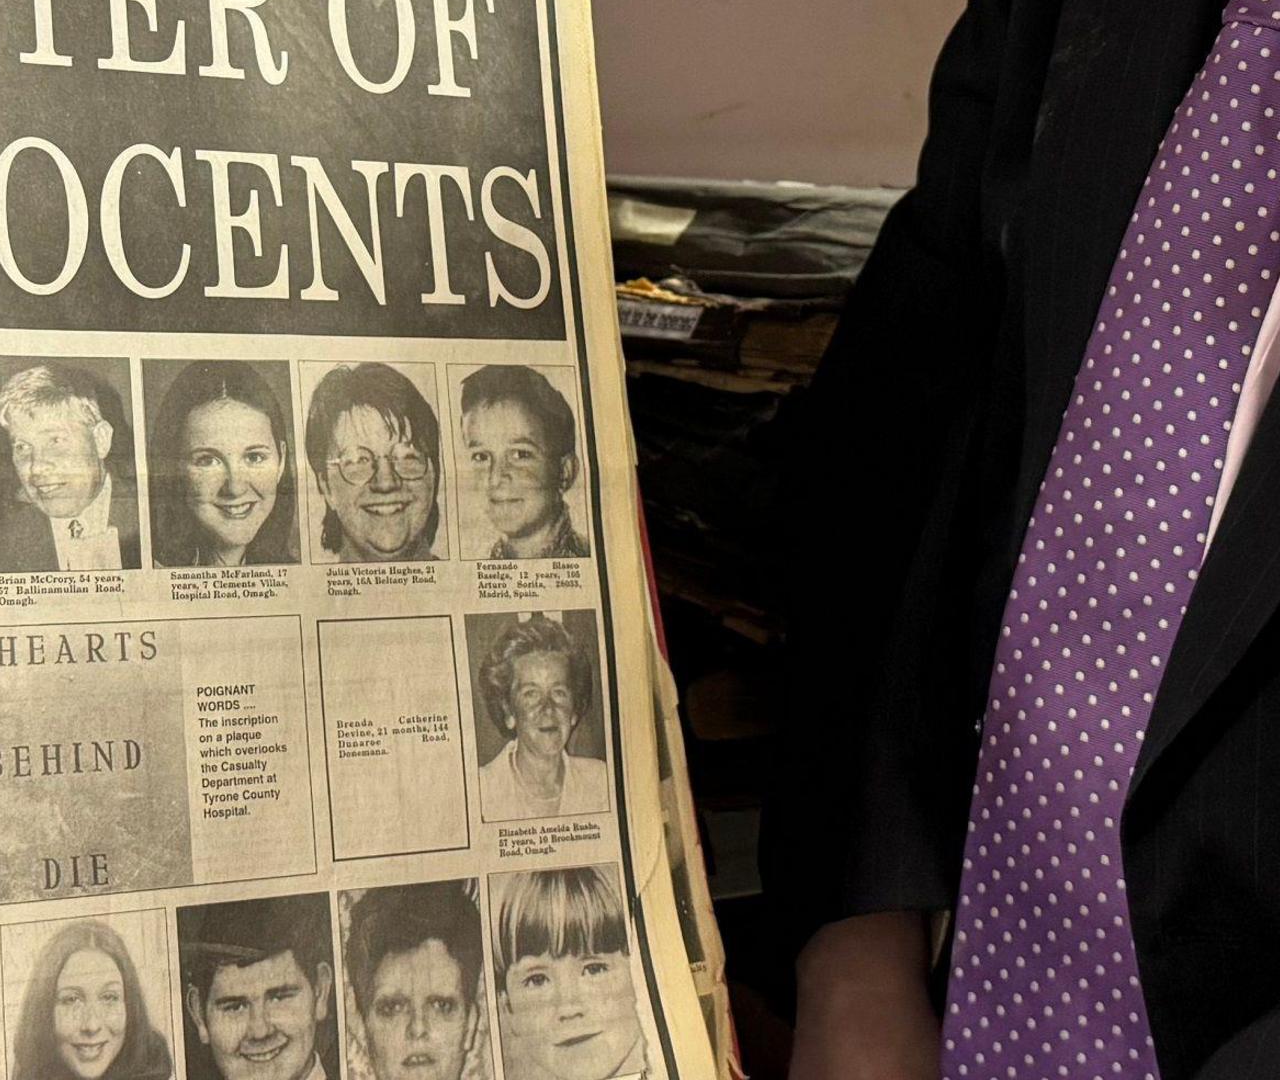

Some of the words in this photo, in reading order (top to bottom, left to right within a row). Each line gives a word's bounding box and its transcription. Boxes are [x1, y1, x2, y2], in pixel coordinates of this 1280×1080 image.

[196, 684, 255, 697] POIGNANT
[196, 699, 240, 712] WORDS
[197, 717, 218, 728] The
[221, 713, 278, 727] inscription
[199, 734, 212, 743] on
[216, 733, 222, 742] a
[225, 730, 261, 744] plaque
[199, 745, 231, 758] which
[234, 742, 287, 756] overlooks
[200, 762, 218, 773] the
[220, 758, 267, 772] Casualty
[201, 774, 263, 790] Department
[266, 772, 276, 783] at
[201, 792, 239, 805] Tyrone
[242, 788, 280, 800] County
[203, 804, 250, 819] Hospital.
[43, 854, 109, 890] DIE
